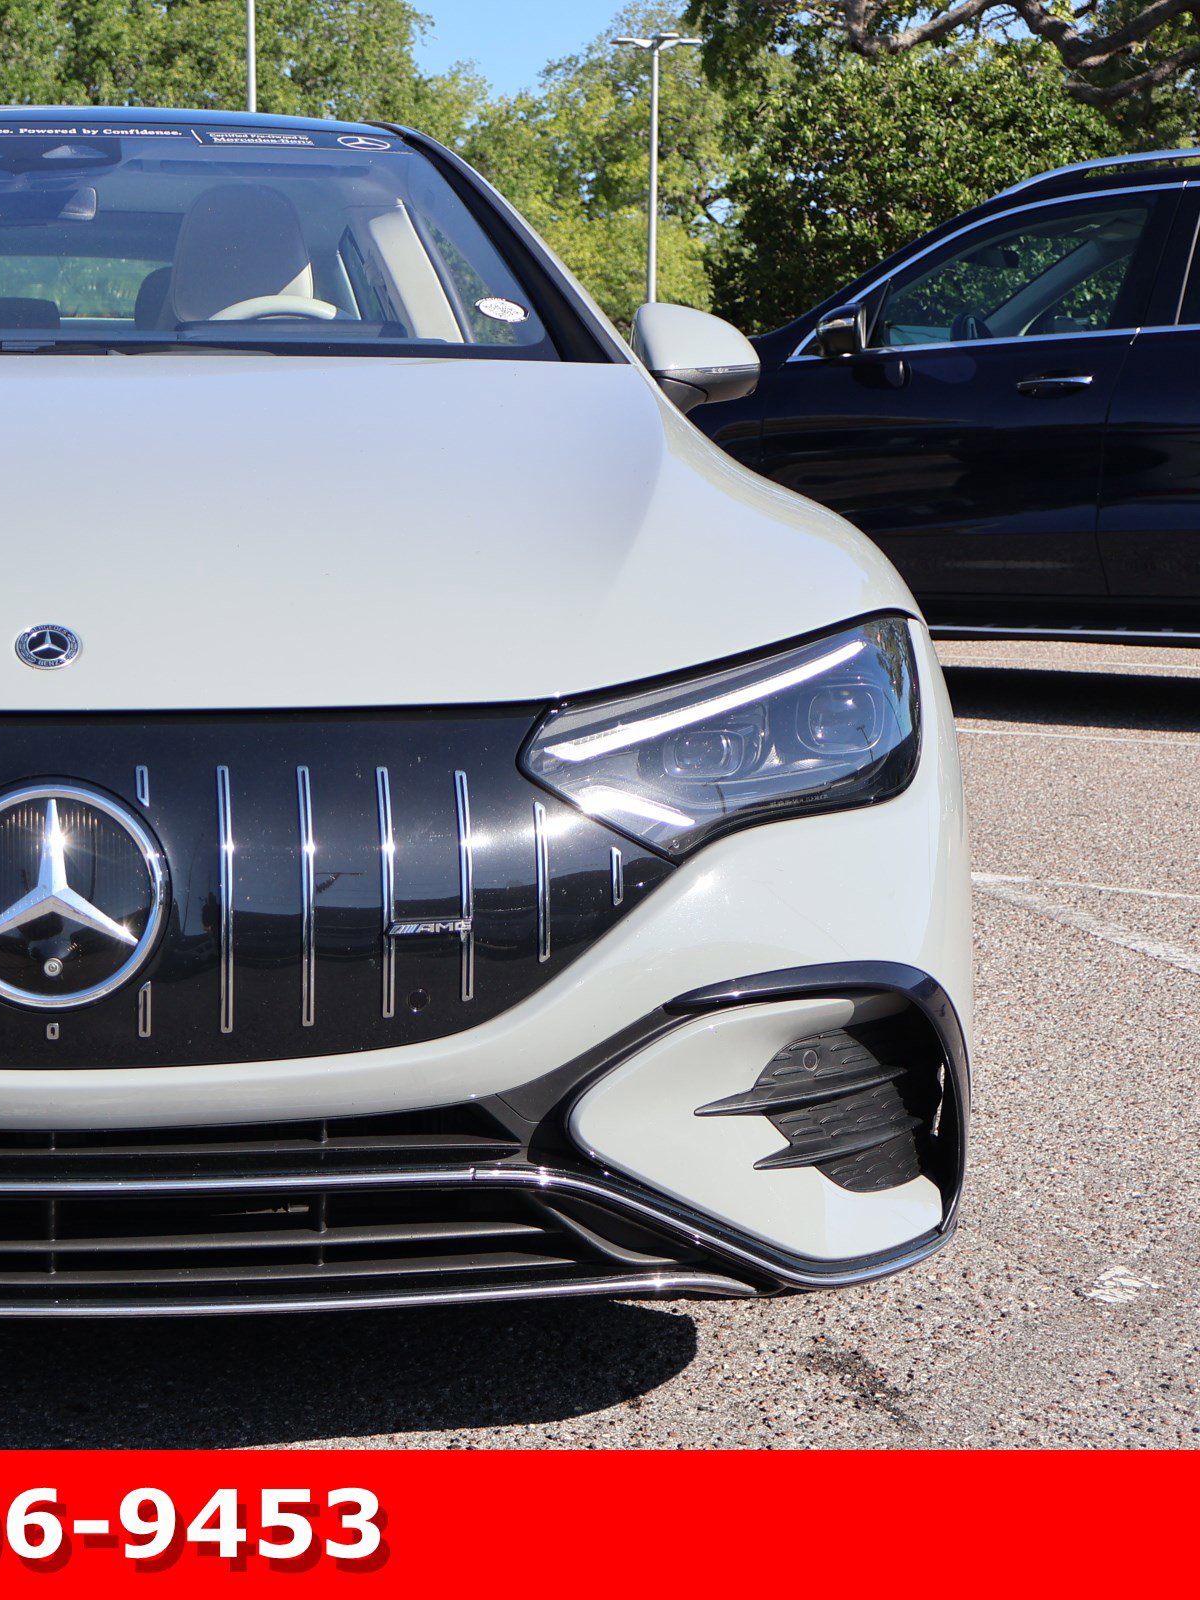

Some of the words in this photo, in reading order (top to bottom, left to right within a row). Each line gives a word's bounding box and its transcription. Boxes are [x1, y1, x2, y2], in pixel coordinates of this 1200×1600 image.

[102, 128, 182, 136] Confidence.
[213, 137, 315, 145] Mercedes-Benz
[38, 659, 60, 667] BENZ
[416, 921, 472, 933] AMG
